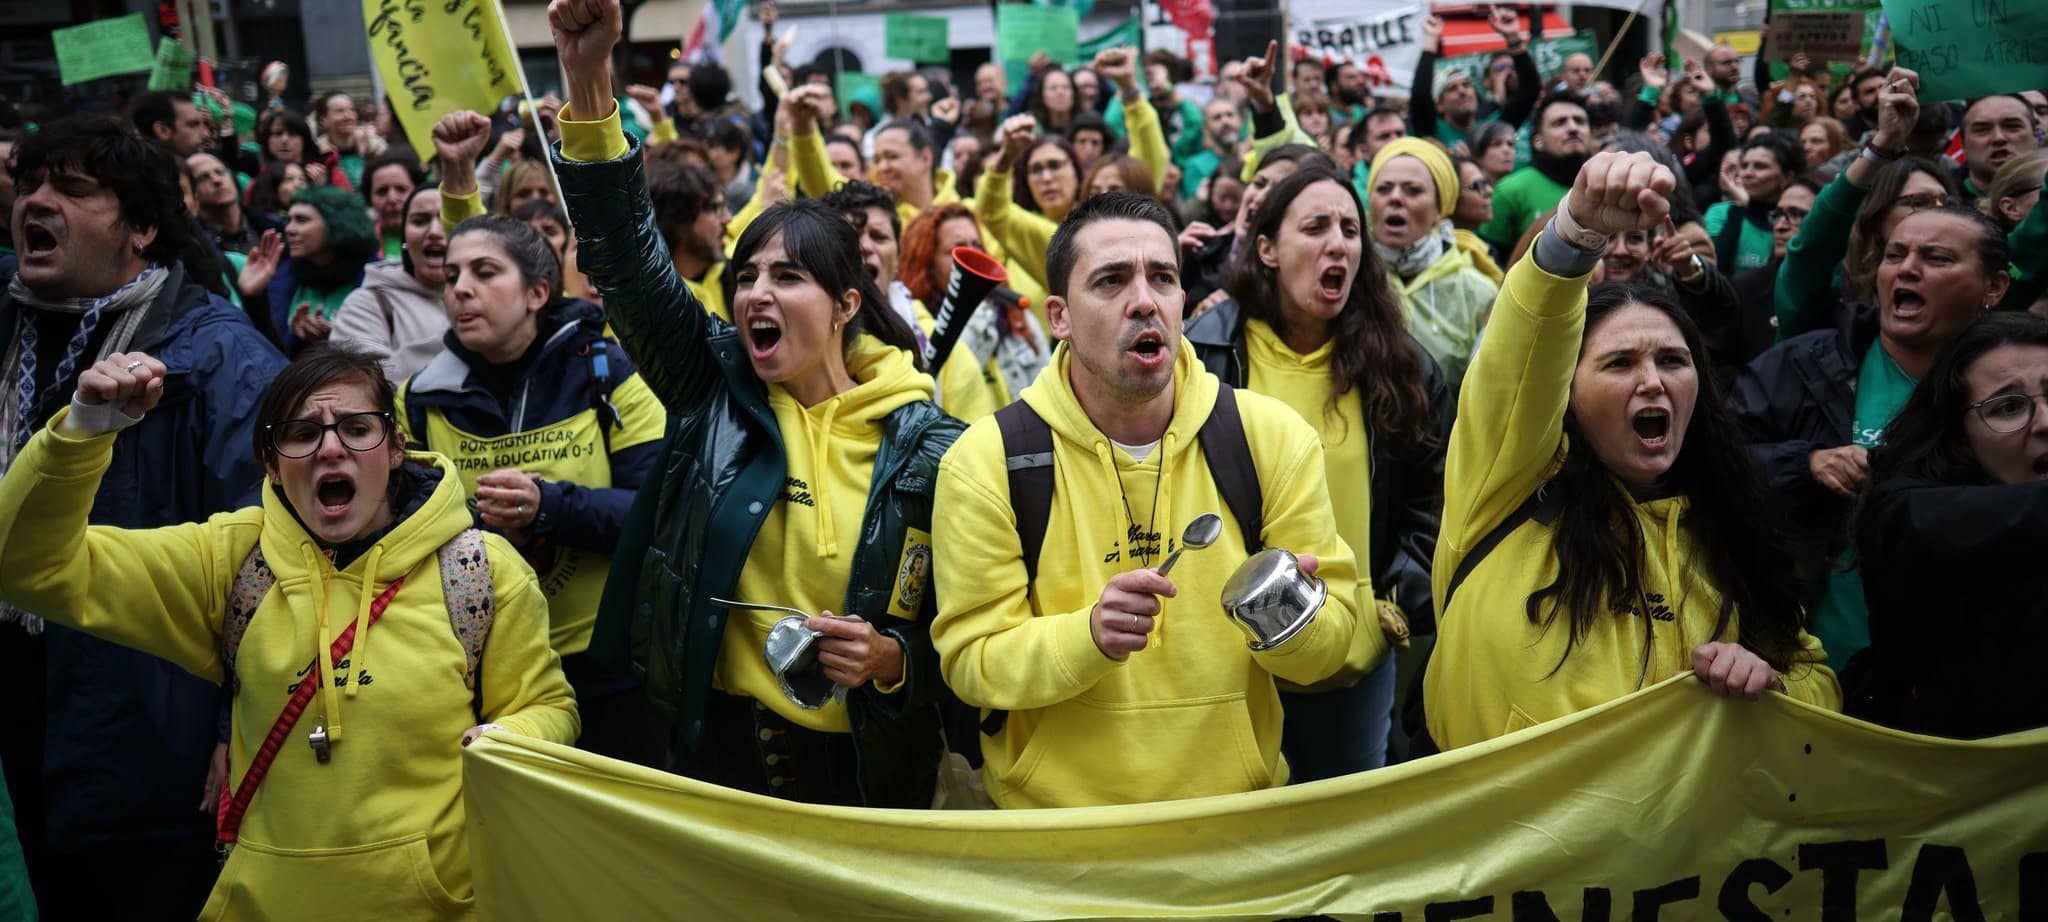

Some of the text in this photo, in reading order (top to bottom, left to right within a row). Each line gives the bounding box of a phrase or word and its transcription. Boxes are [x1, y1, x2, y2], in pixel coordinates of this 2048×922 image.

[1909, 0, 2008, 35] NI UN
[460, 431, 574, 453] POR DIGNIFICAR
[494, 447, 568, 468] EDUCATIVA
